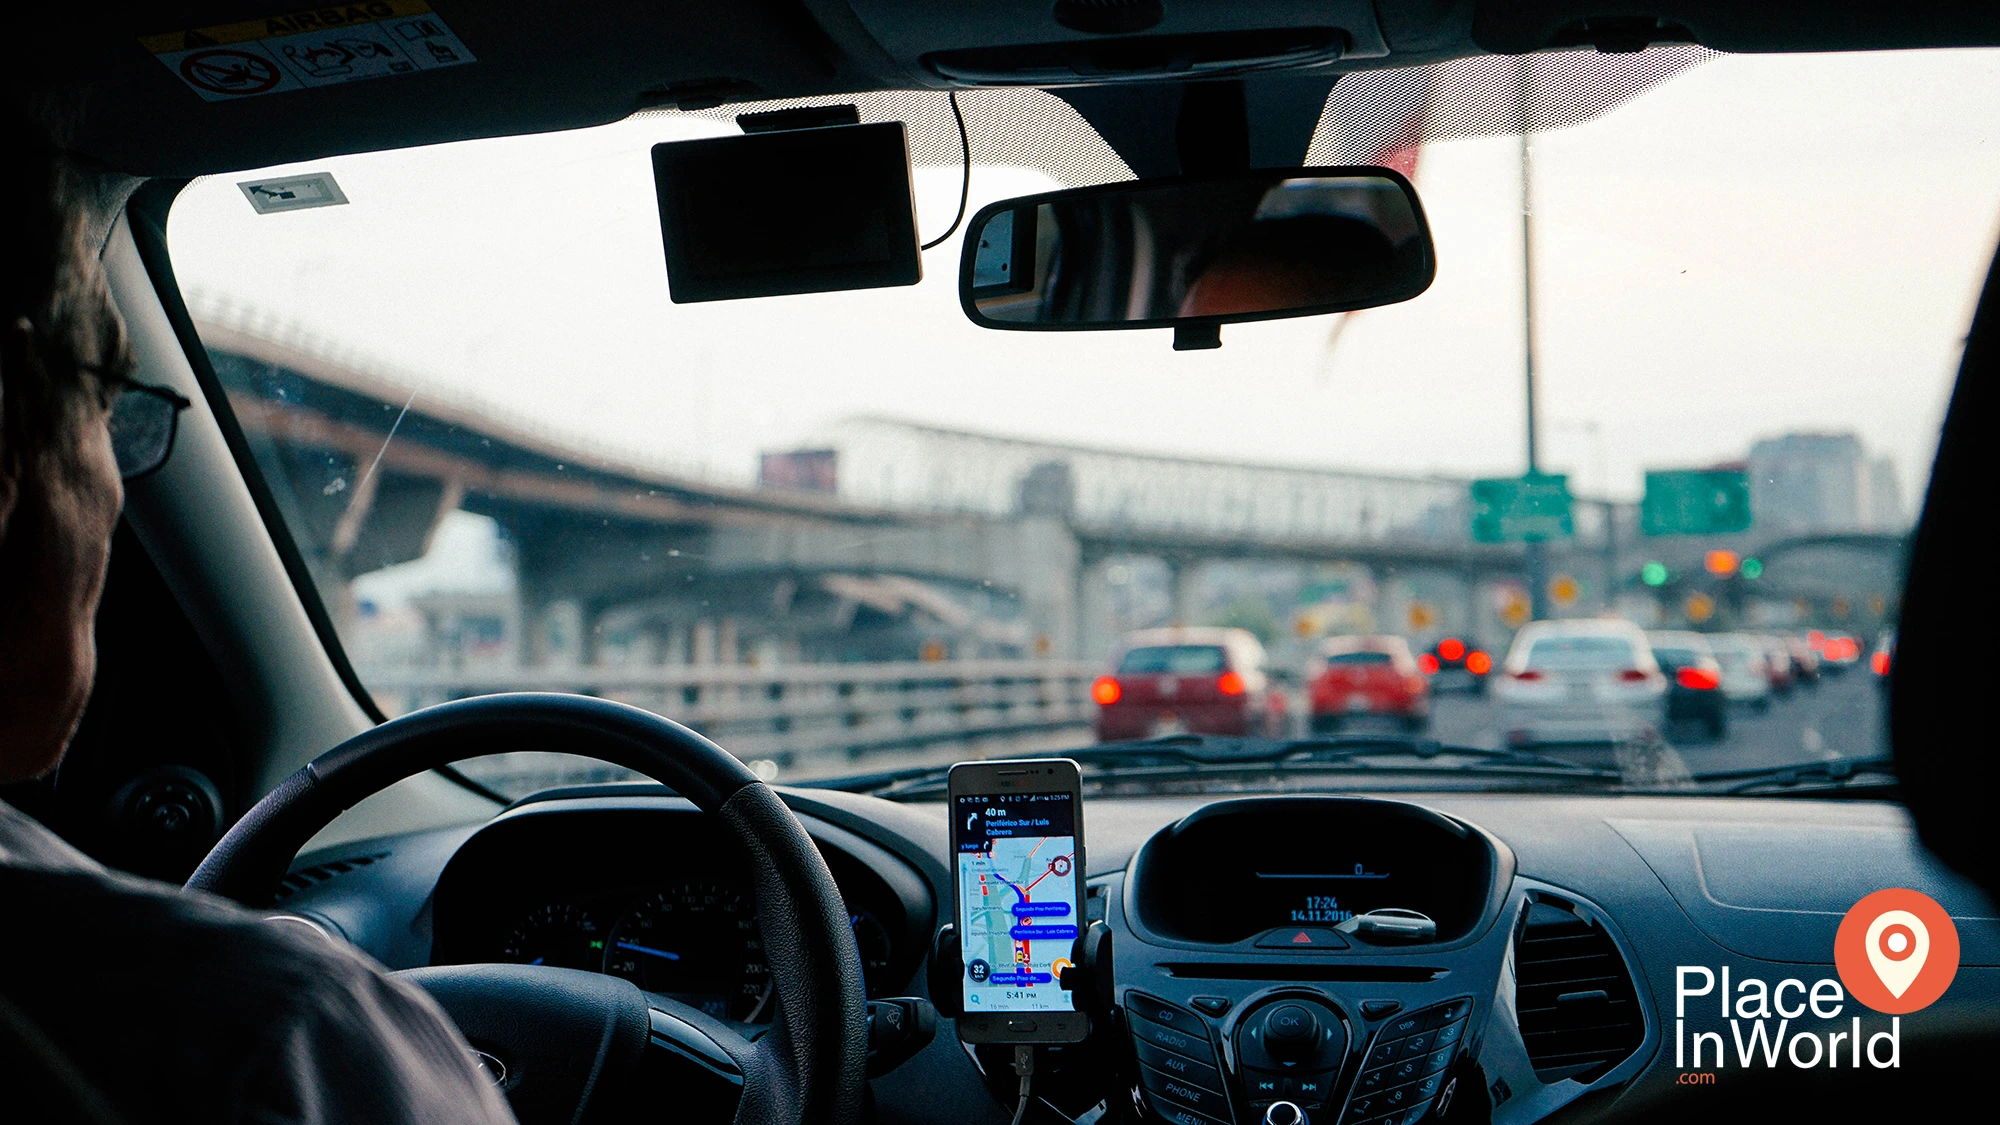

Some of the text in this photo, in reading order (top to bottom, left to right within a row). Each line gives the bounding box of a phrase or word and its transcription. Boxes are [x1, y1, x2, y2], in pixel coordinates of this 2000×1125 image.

[266, 2, 395, 34] AIRBAG
[985, 808, 1006, 817] 40 m
[1035, 818, 1050, 826] Luis
[1306, 896, 1338, 909] 17:24
[1290, 909, 1353, 922] 14.11.2016
[622, 961, 636, 972] 20
[745, 963, 763, 974] 200
[973, 964, 985, 974] 32
[992, 975, 1016, 983] Segundo
[742, 983, 761, 995] 220
[1006, 991, 1024, 999] 5:41
[1158, 1010, 1174, 1021] CD
[1280, 1016, 1299, 1027] OK
[1398, 1020, 1416, 1031] DSP
[1446, 1027, 1455, 1036] 3
[1155, 1031, 1187, 1048] RADIO
[1415, 1037, 1424, 1047] 2
[1386, 1047, 1392, 1055] 1
[1436, 1053, 1444, 1062] 6
[1165, 1058, 1187, 1072] AUX
[1404, 1063, 1413, 1073] 5
[1373, 1072, 1381, 1081] 4
[1426, 1080, 1434, 1089] 9
[1165, 1083, 1202, 1103] PHONE
[1394, 1090, 1403, 1100] 8
[1363, 1100, 1371, 1109] 7
